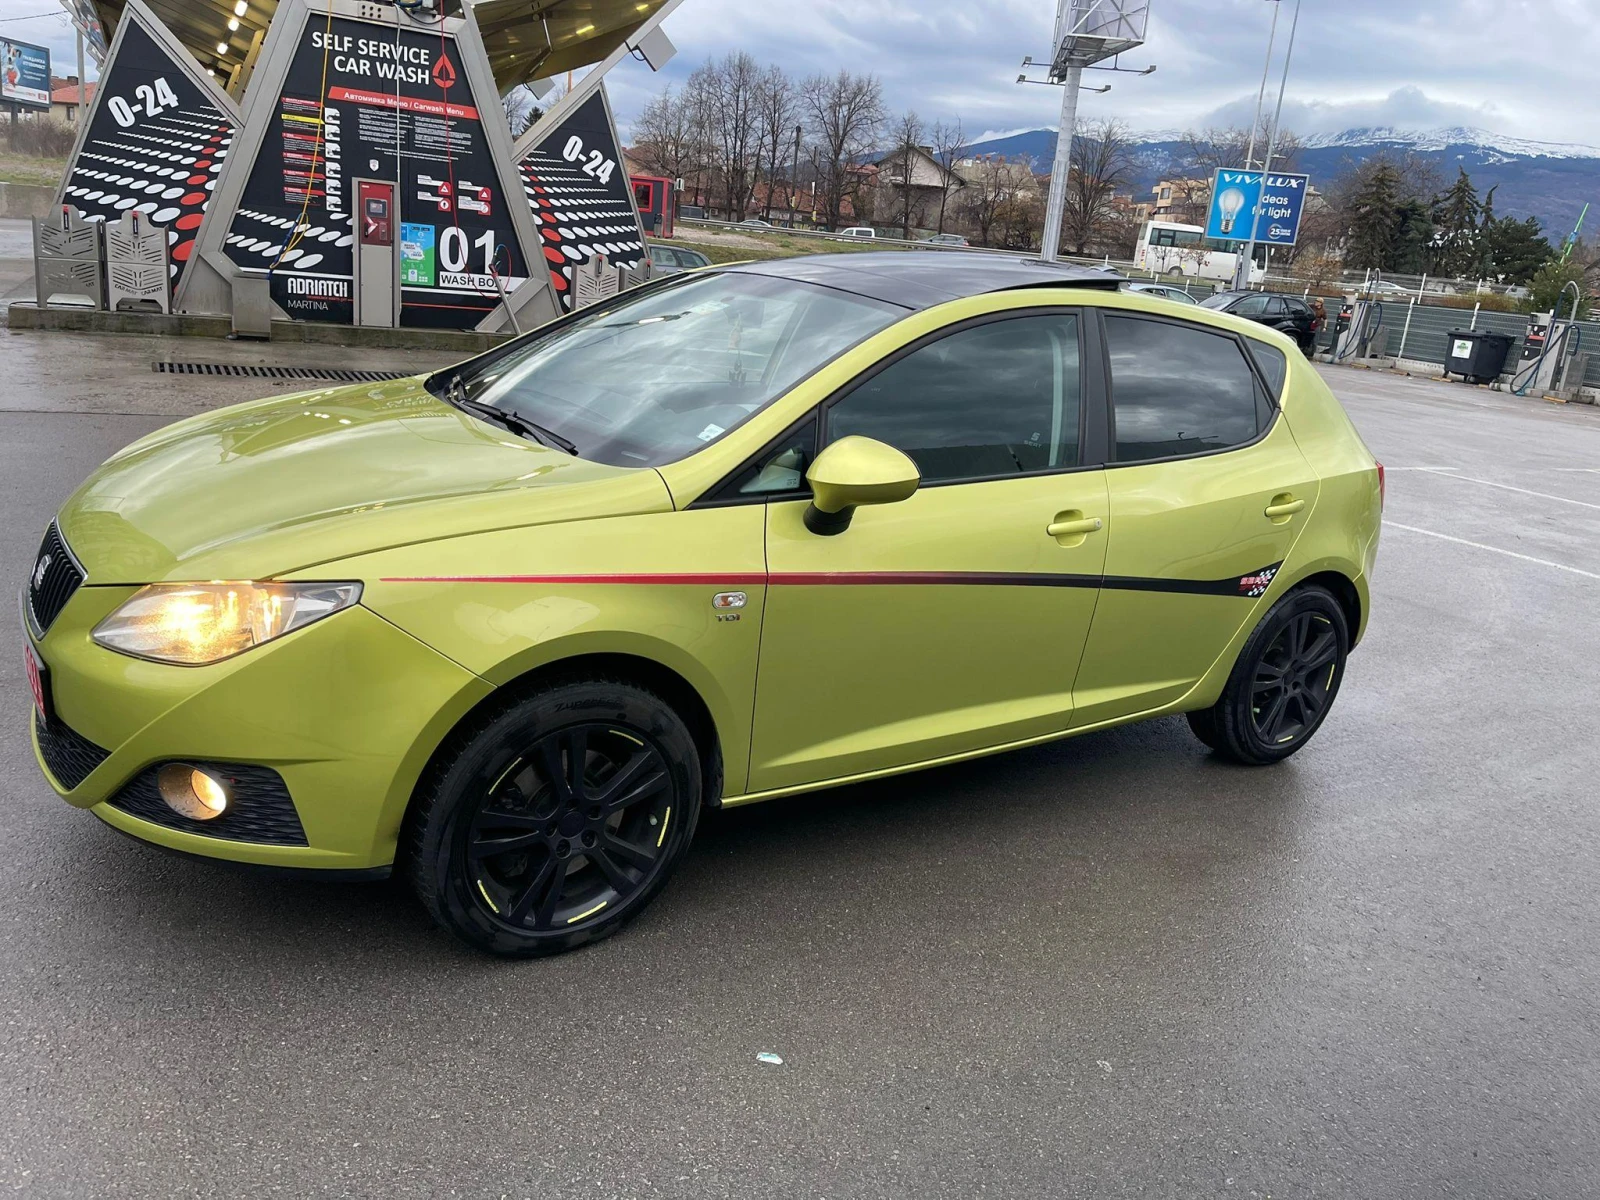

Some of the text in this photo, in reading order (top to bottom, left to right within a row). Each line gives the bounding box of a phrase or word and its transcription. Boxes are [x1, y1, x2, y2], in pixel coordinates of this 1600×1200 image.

[312, 31, 429, 65] SELF SERVICE
[334, 55, 430, 85] CAR WASH
[107, 77, 179, 127] 0-24
[344, 92, 385, 105] Автомивка
[413, 102, 444, 113] Carwash
[446, 107, 465, 116] Menu
[563, 135, 615, 185] 0-24
[1223, 173, 1302, 188] VIVALUX
[1259, 194, 1288, 205] deas
[1268, 207, 1291, 219] light
[440, 226, 495, 274] 01
[441, 275, 502, 288] WASH BO
[287, 299, 329, 310] MARTINA
